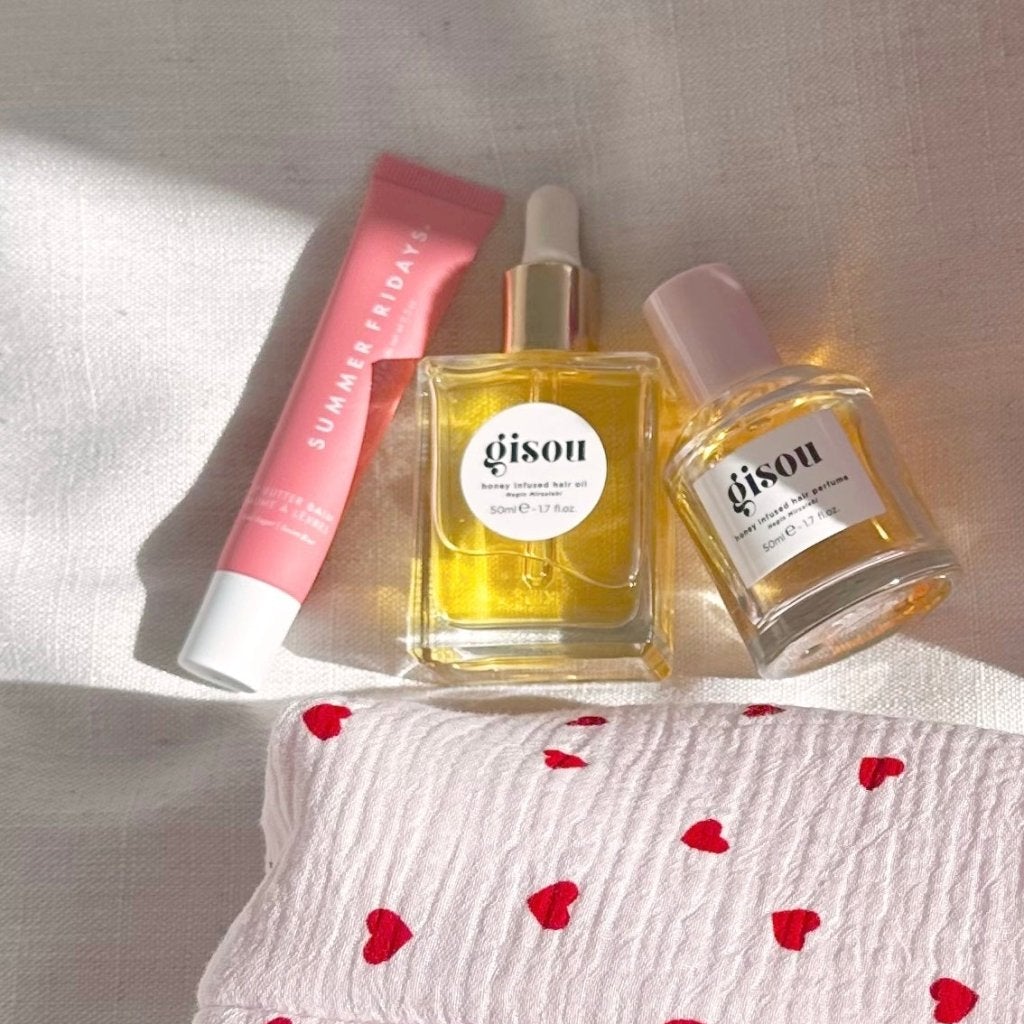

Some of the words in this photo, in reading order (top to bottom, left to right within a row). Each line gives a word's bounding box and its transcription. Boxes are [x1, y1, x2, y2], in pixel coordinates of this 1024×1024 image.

[308, 340, 375, 450] SUMMER
[481, 482, 511, 491] honey
[513, 481, 550, 489] infused
[552, 481, 572, 489] hair
[574, 480, 588, 488] oil
[483, 432, 587, 478] gisou
[727, 441, 824, 518] gisou
[734, 523, 758, 542] honey
[758, 502, 790, 525] infused
[790, 491, 809, 505] hair
[812, 474, 849, 495] perfume
